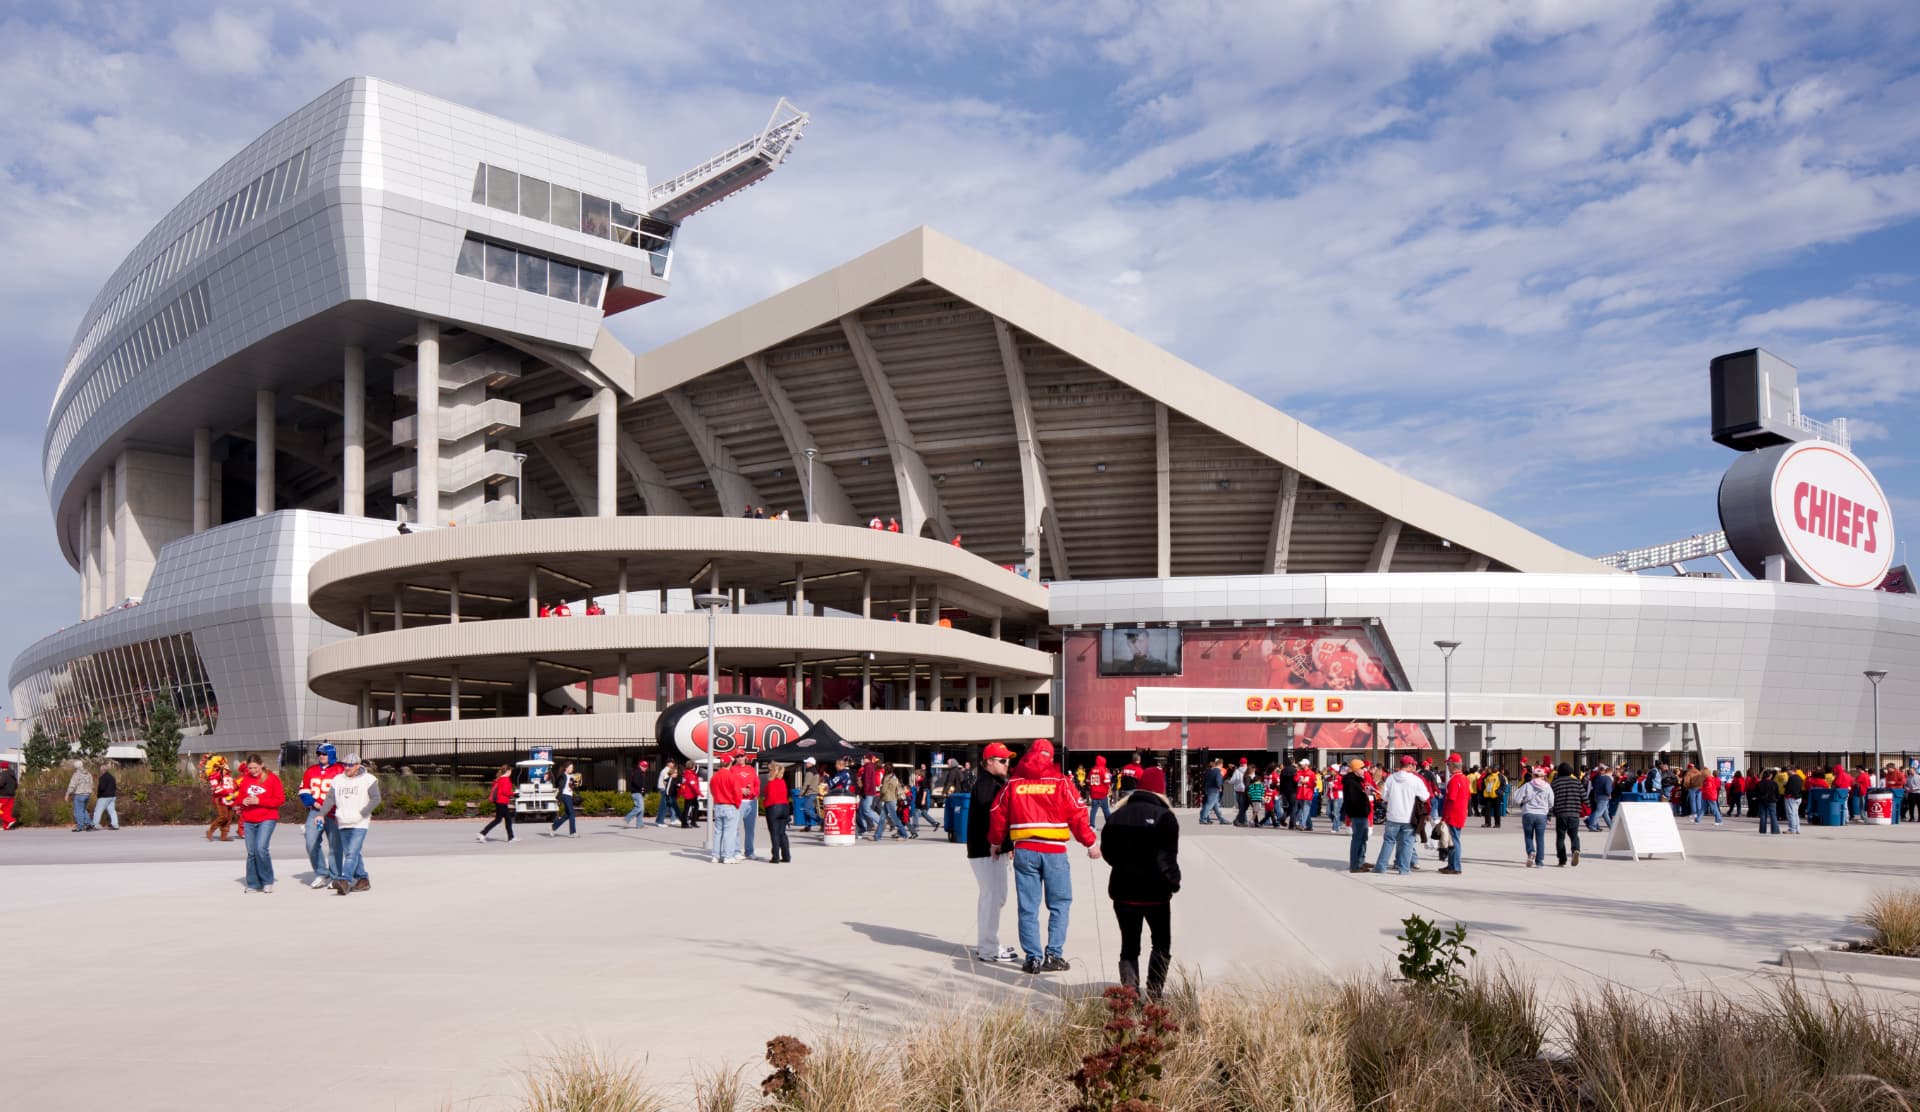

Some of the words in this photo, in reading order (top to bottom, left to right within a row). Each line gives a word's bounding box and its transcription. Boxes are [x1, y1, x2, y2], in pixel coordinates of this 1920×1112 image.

[1793, 481, 1879, 554] CHIEFS
[1246, 696, 1315, 713] GATE
[1325, 697, 1344, 713] D
[1555, 702, 1616, 717] GATE
[1625, 703, 1641, 717] D
[699, 705, 752, 719] SORTS
[755, 706, 795, 725] RADIO
[712, 721, 787, 755] 810
[1016, 784, 1057, 795] CHIEFS
